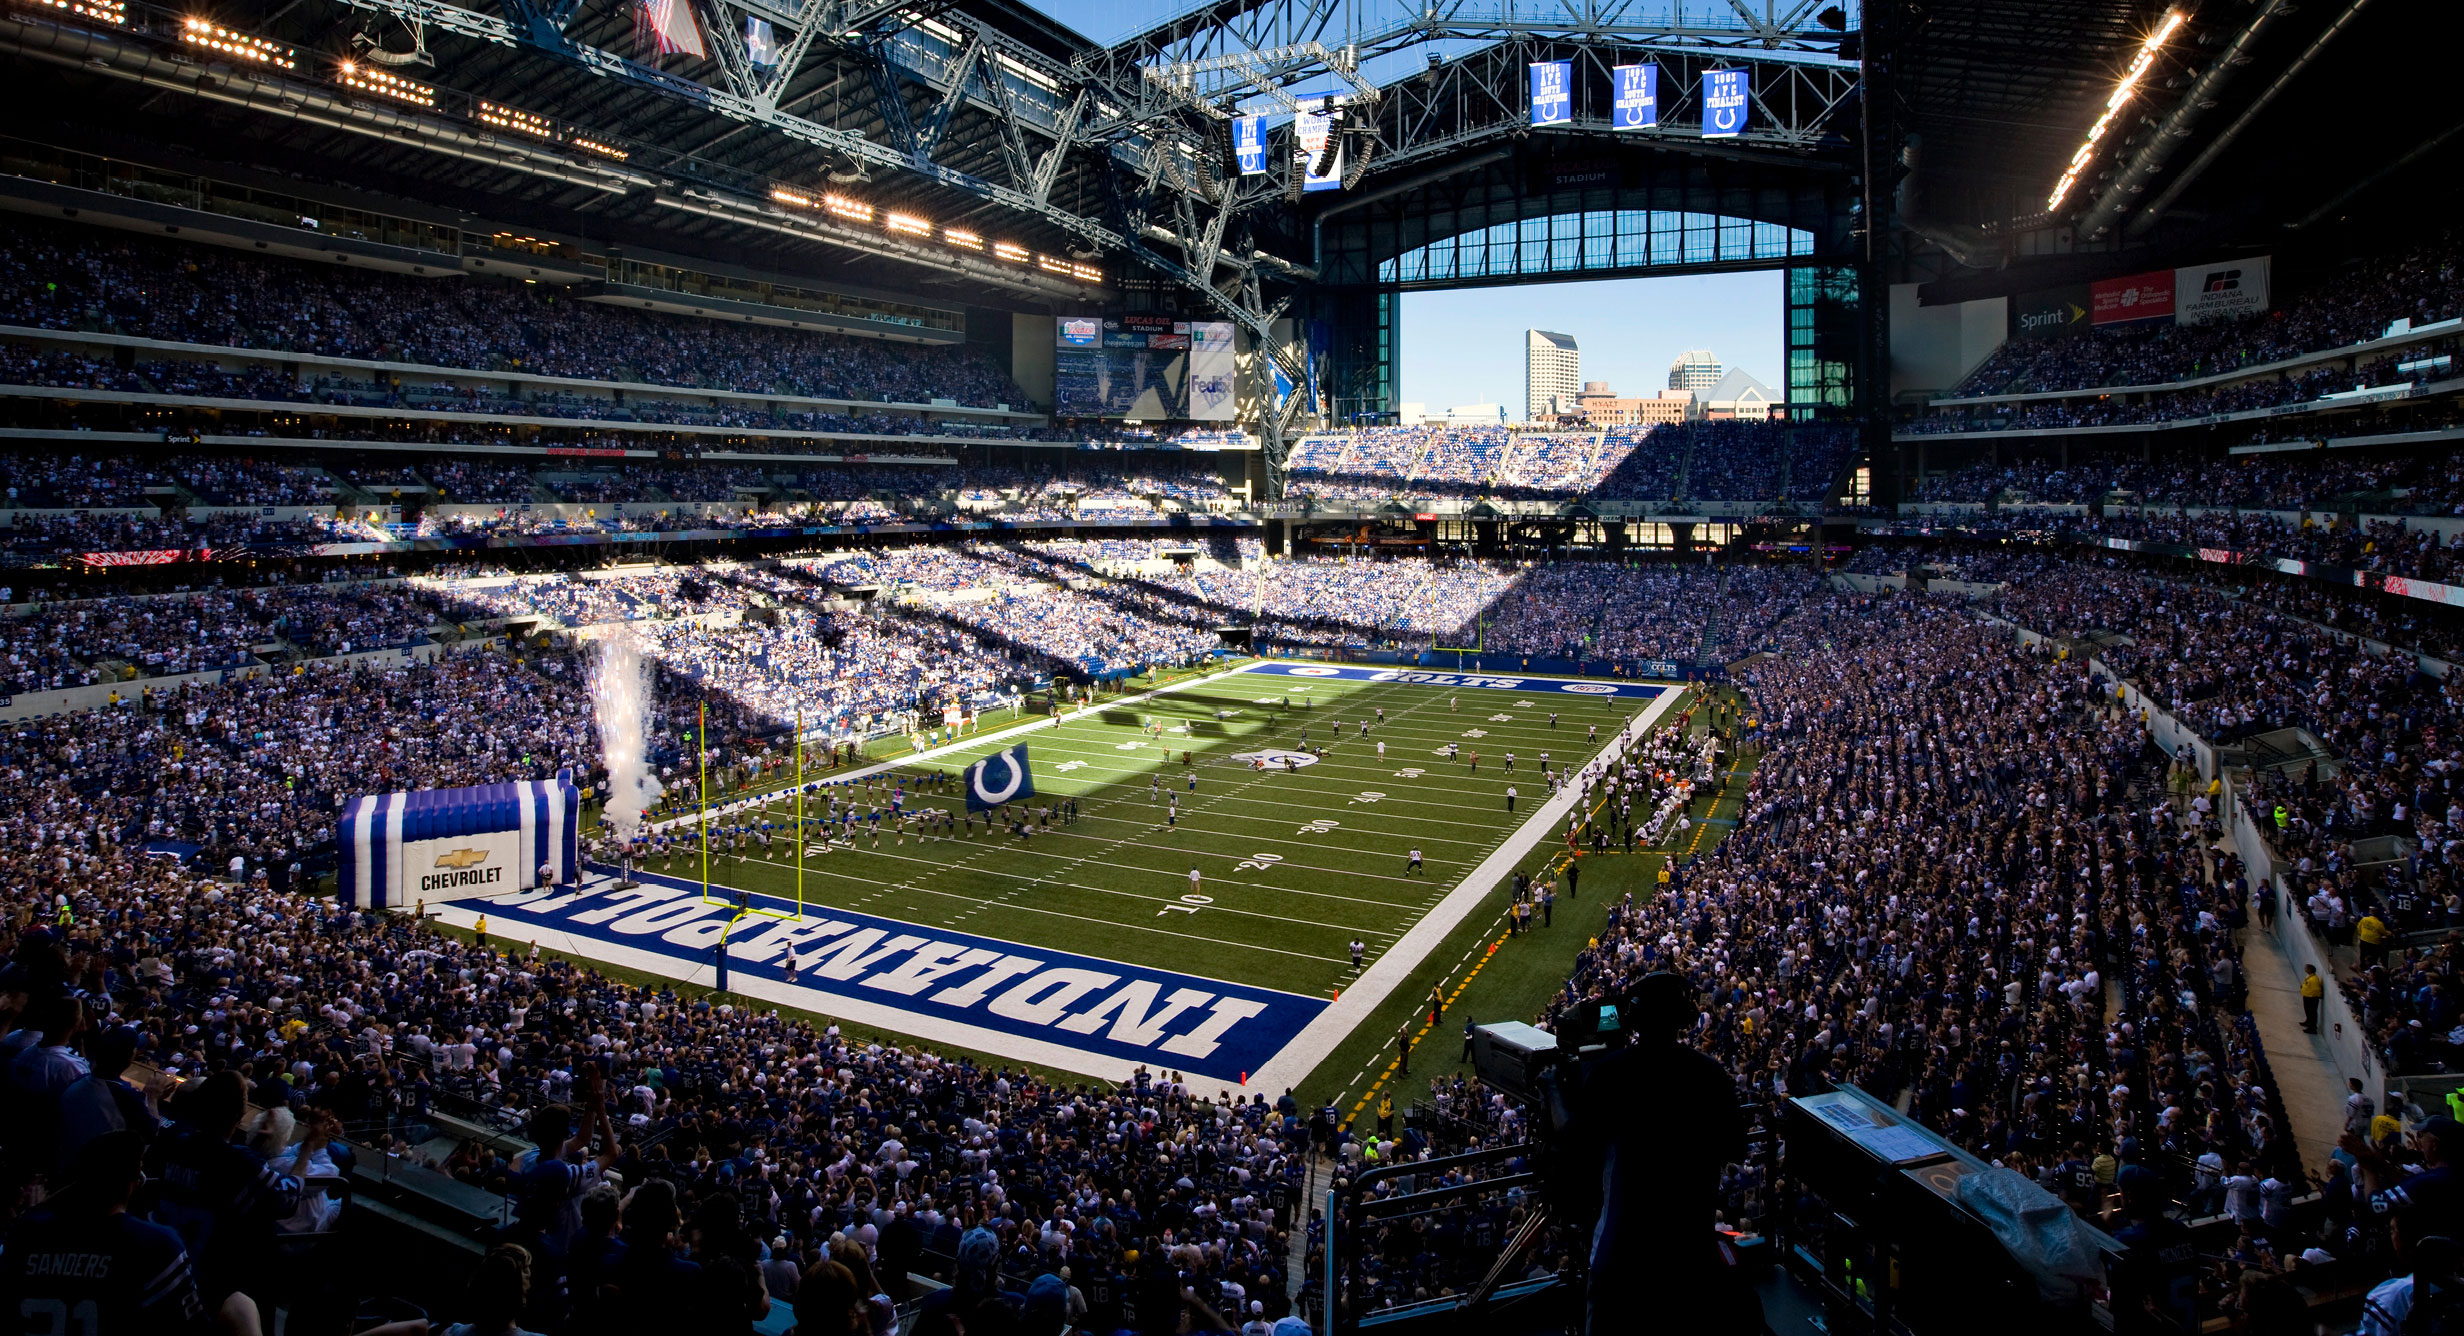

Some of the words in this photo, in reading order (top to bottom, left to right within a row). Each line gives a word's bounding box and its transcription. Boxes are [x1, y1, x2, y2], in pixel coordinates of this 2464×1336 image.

[1541, 64, 1560, 75] 2005
[1540, 73, 1561, 87] AFC
[1624, 76, 1647, 90] AFC
[1541, 85, 1560, 95] SOUTH
[1624, 89, 1646, 99] SOUTH
[1713, 84, 1737, 97] AFC
[1533, 93, 1568, 105] CHAMPIONS
[1616, 96, 1654, 109] CHAMPIONS
[1706, 95, 1744, 108] FINALIST
[1556, 172, 1607, 184] STADIUM
[2200, 290, 2243, 302] INDIANA
[1124, 316, 1153, 325] LUCAS
[1155, 317, 1171, 325] OIL
[2020, 308, 2064, 331] Sprint
[1191, 375, 1232, 393] FedEx
[168, 435, 190, 445] Sprint
[1369, 672, 1524, 689] COLTS
[1352, 791, 1387, 804] 40
[1300, 819, 1340, 834] 30
[1239, 853, 1284, 871] 20
[421, 866, 502, 892] CHEVROLET
[1165, 894, 1215, 915] 10
[403, 1090, 416, 1107] 18
[1325, 1113, 1335, 1124] 18
[2075, 1173, 2092, 1187] 93
[1475, 1232, 1491, 1246] 18
[25, 1252, 111, 1279] SANDERS
[1092, 1286, 1109, 1302] 18
